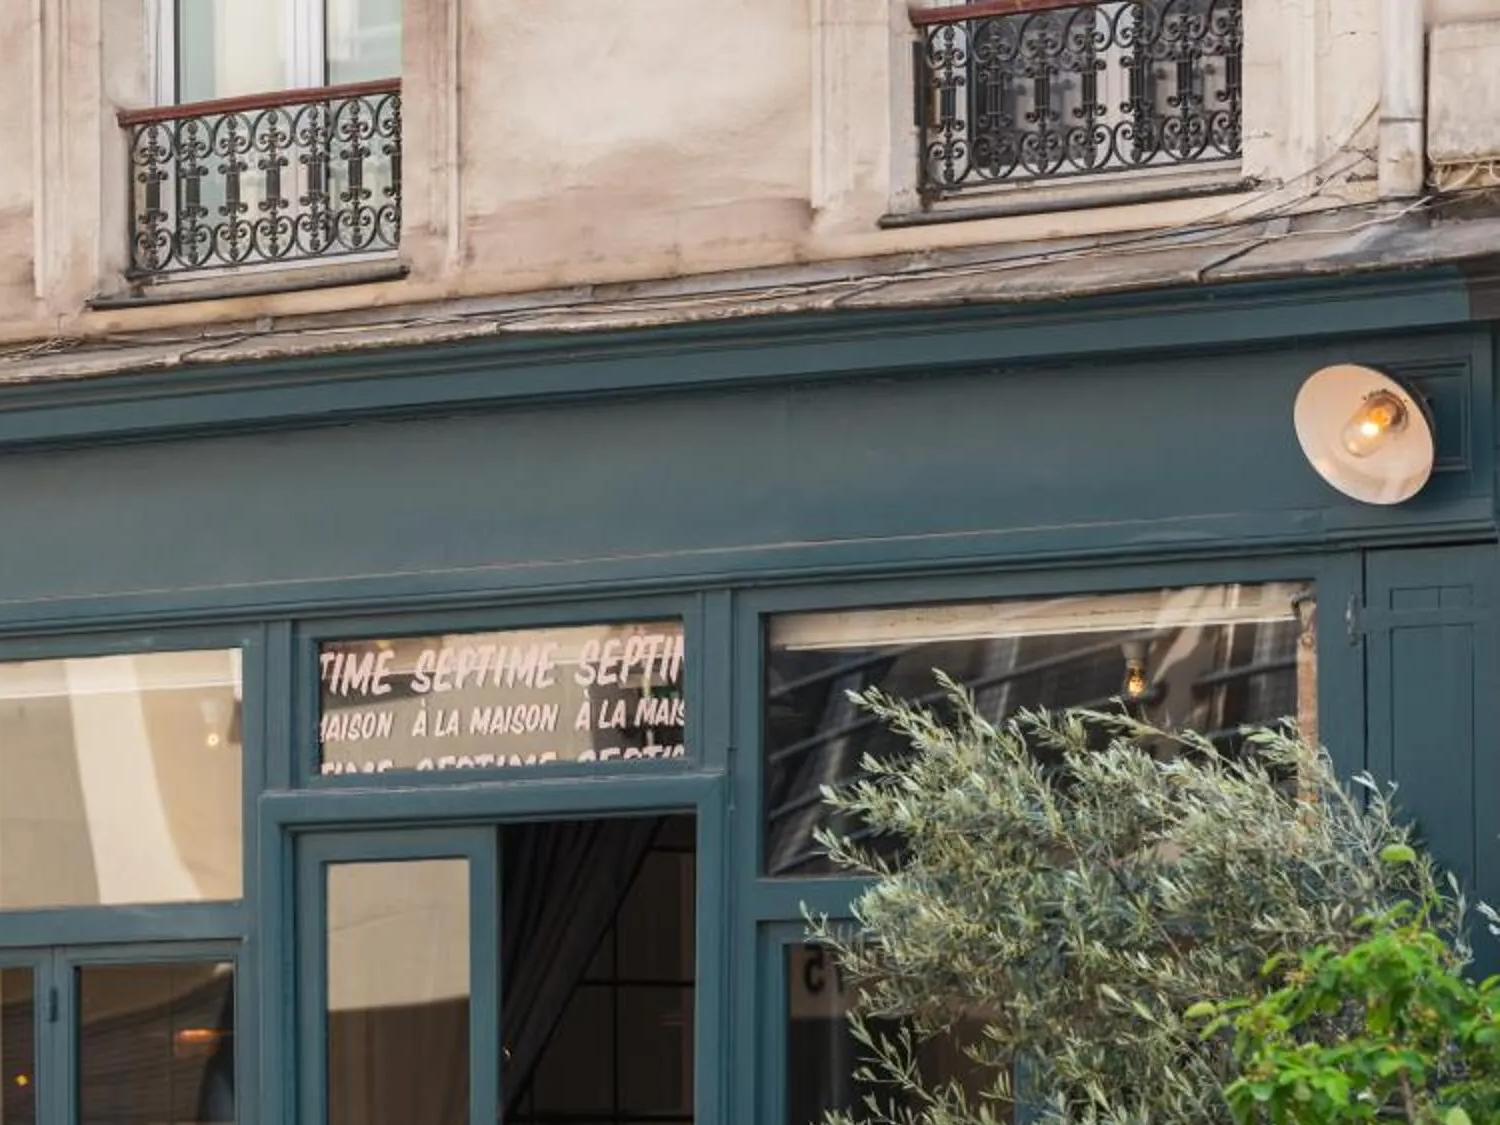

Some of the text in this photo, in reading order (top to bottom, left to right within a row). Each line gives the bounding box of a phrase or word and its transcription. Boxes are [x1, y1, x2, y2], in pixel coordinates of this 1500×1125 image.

[319, 650, 395, 696] TIME
[410, 642, 558, 692] SEPTIME
[411, 698, 427, 737] À
[435, 709, 460, 737] LA
[470, 703, 560, 736] MAISON
[575, 688, 591, 732] À
[598, 698, 627, 729] LA
